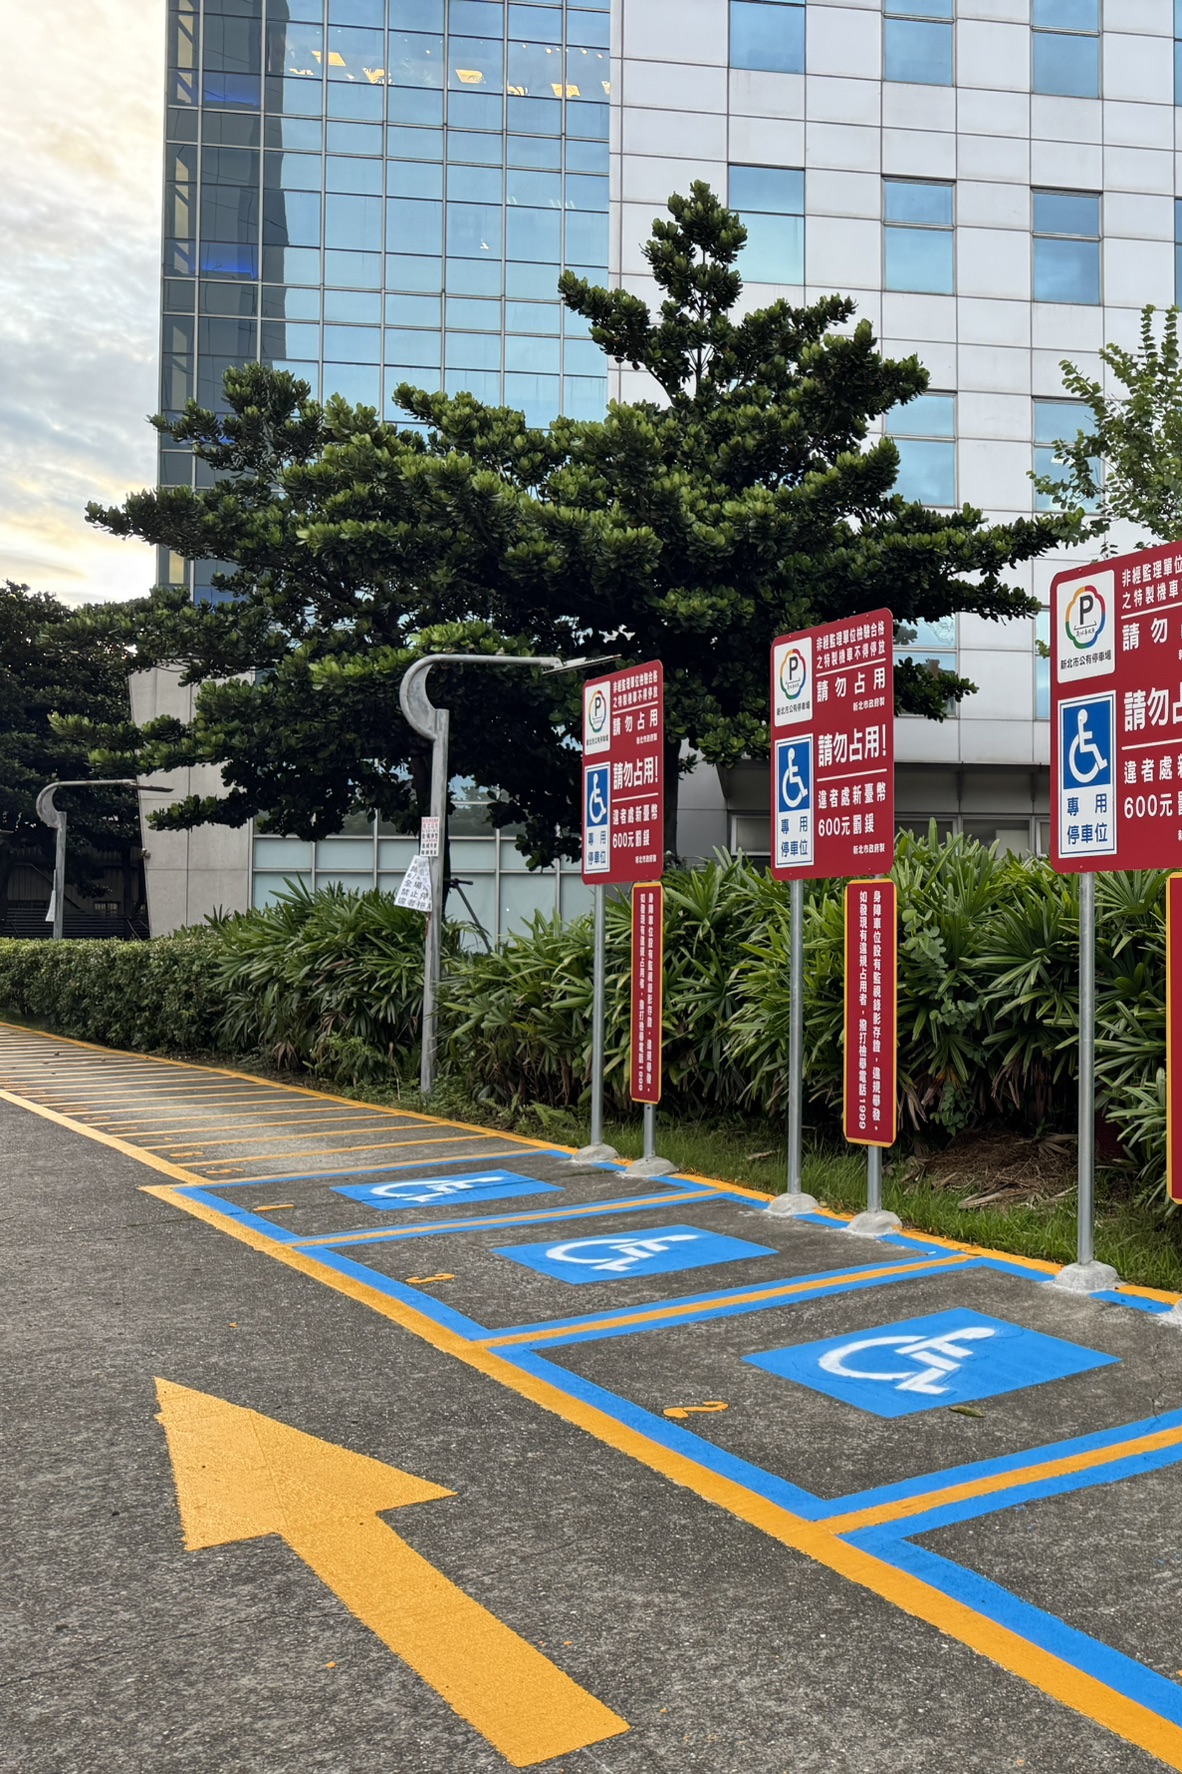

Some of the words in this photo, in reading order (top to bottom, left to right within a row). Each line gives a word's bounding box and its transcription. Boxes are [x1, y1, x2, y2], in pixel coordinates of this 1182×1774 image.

[1080, 594, 1094, 626] P
[789, 656, 799, 681] P
[595, 696, 602, 717] P
[817, 723, 887, 768] 請勿占用!
[1066, 823, 1109, 845] 停車位
